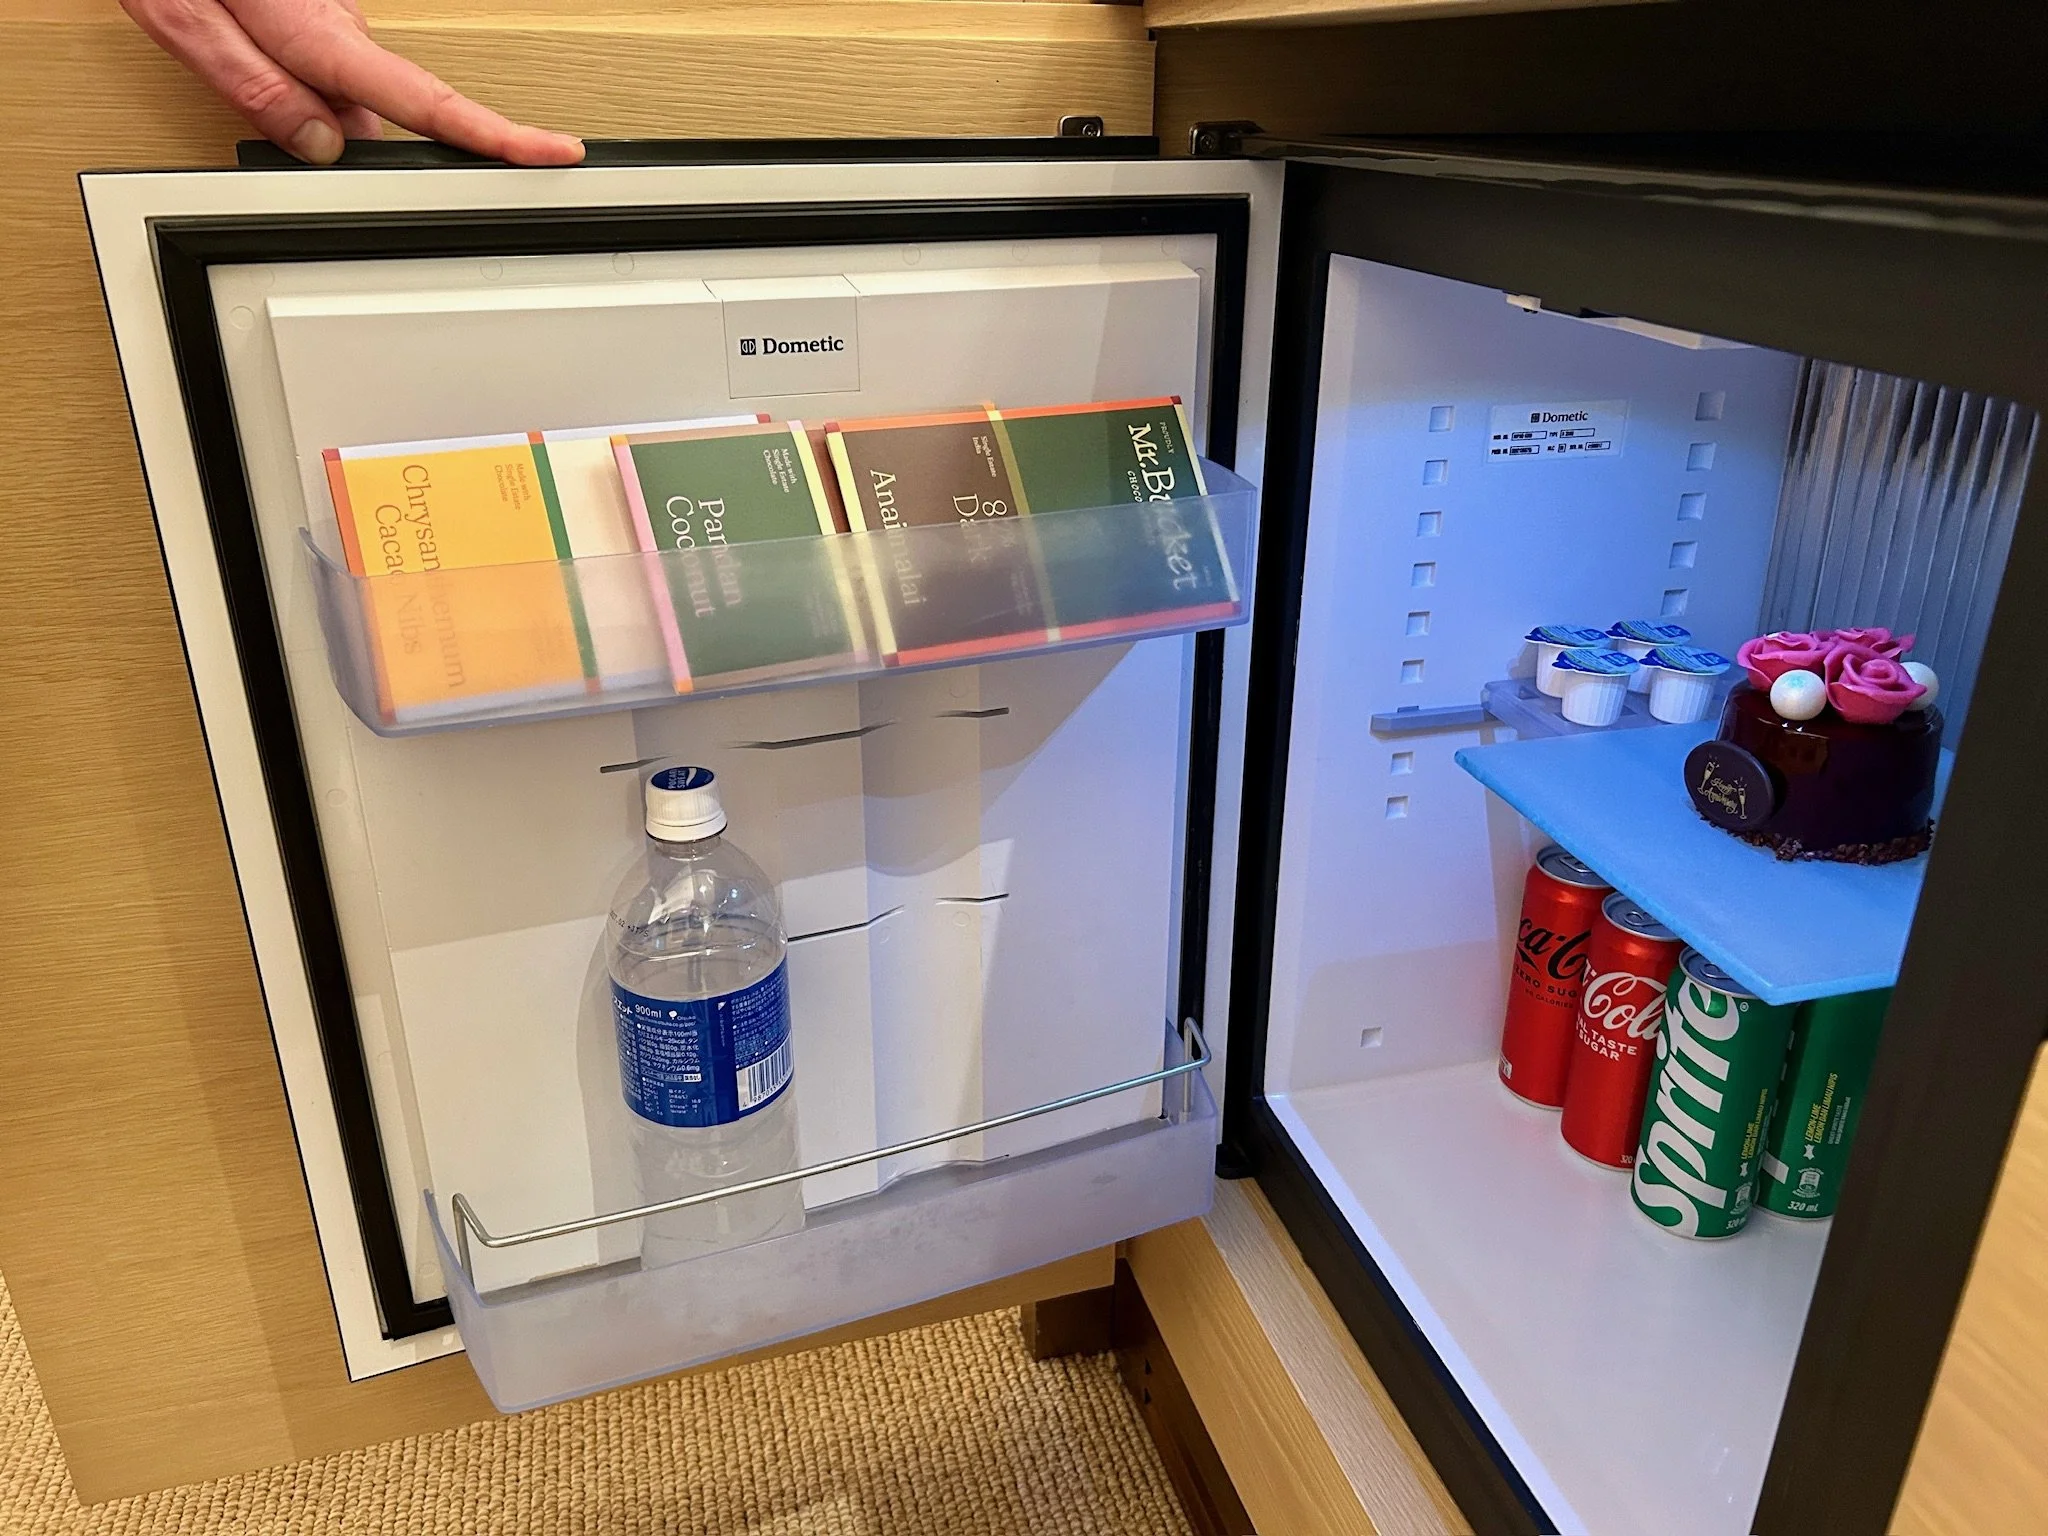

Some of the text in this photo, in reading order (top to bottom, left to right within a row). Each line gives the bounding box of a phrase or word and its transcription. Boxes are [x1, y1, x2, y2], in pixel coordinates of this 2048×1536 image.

[762, 335, 844, 355] Dometic
[1542, 410, 1588, 423] Dometic
[972, 436, 982, 455] India
[980, 435, 997, 478] Single Estate
[1159, 421, 1175, 455] PROUDLY
[494, 464, 508, 502] Chocolate
[515, 463, 532, 501] Made with
[763, 449, 778, 486] Chocolate
[771, 448, 790, 494] Single Estate
[781, 448, 798, 485] Made with
[504, 463, 521, 511] Single Estate
[665, 495, 716, 618] Coconut
[698, 497, 743, 607] Pandan
[397, 592, 427, 656] Nibs
[1547, 985, 1578, 998] SUG
[634, 1004, 662, 1018] 900ml
[1578, 1029, 1620, 1062] SUGAR
[1591, 1028, 1638, 1056] TASTE
[1632, 976, 1740, 1237] Sprite
[1804, 1103, 1822, 1141] LEMON-LIME
[1813, 1119, 1826, 1144] LEMON
[1787, 1200, 1806, 1211] 320
